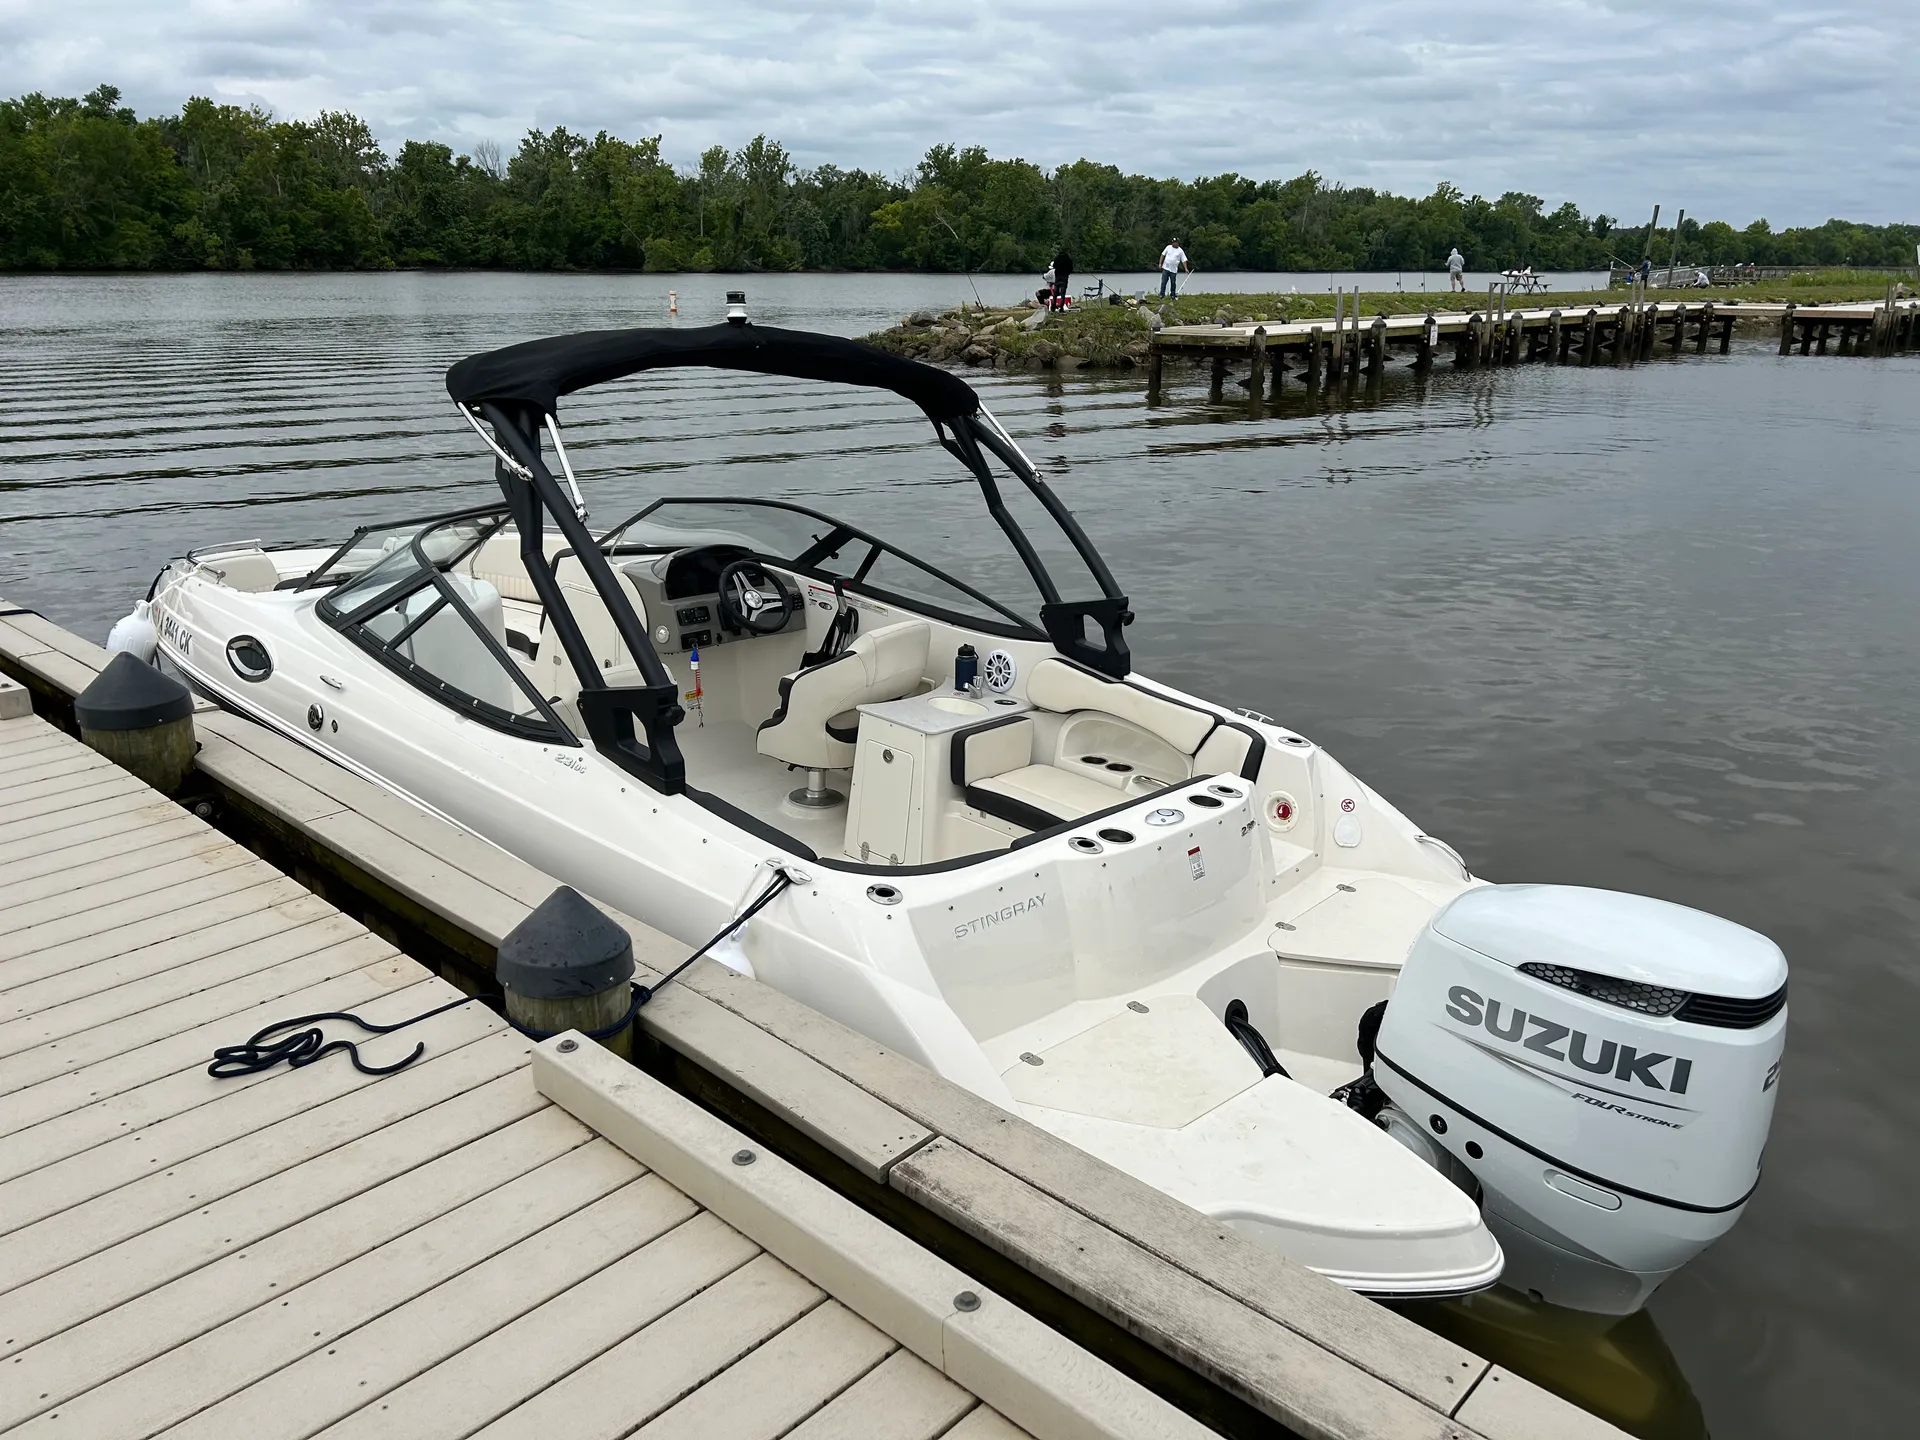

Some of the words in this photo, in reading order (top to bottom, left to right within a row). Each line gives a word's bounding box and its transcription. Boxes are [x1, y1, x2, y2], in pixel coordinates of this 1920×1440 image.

[180, 629, 192, 655] CK
[954, 892, 1046, 939] STINGRAY
[1445, 985, 1693, 1095] SUZUKI
